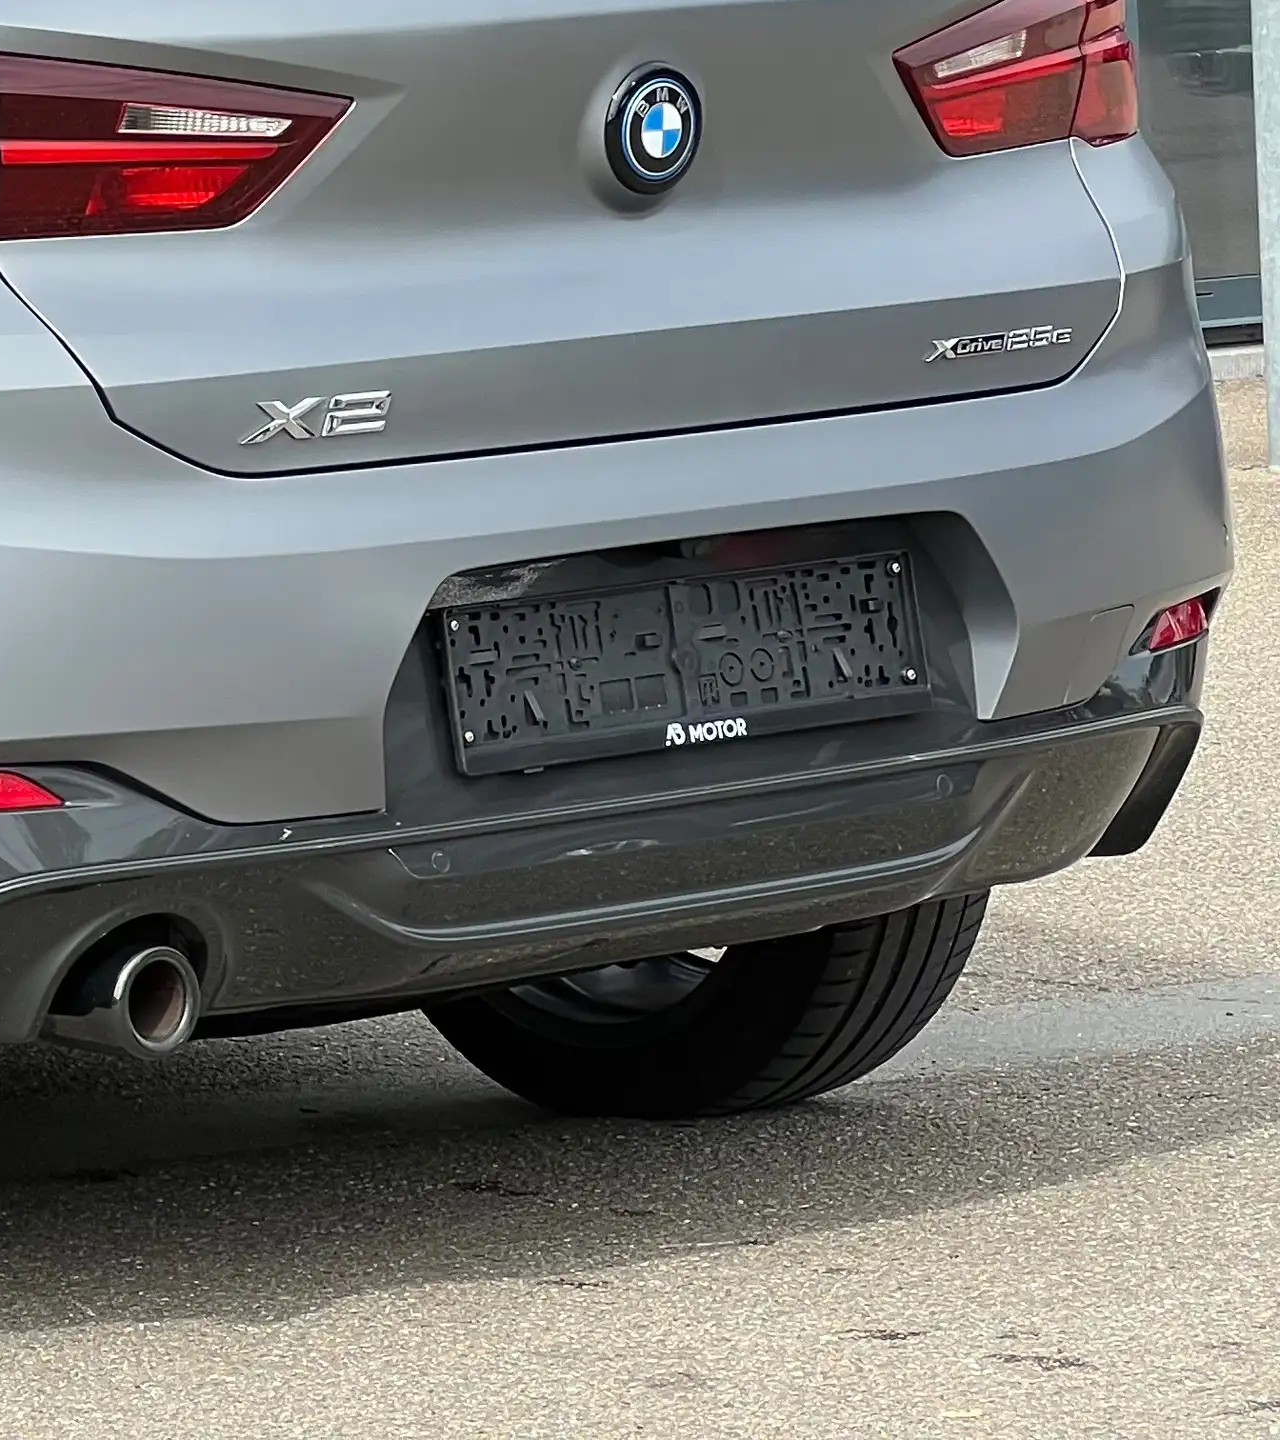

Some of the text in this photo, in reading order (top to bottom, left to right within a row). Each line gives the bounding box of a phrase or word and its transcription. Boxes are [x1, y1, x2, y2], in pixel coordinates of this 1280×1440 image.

[635, 86, 689, 118] BMW
[239, 390, 392, 445] X2
[688, 717, 748, 744] MOTOR
